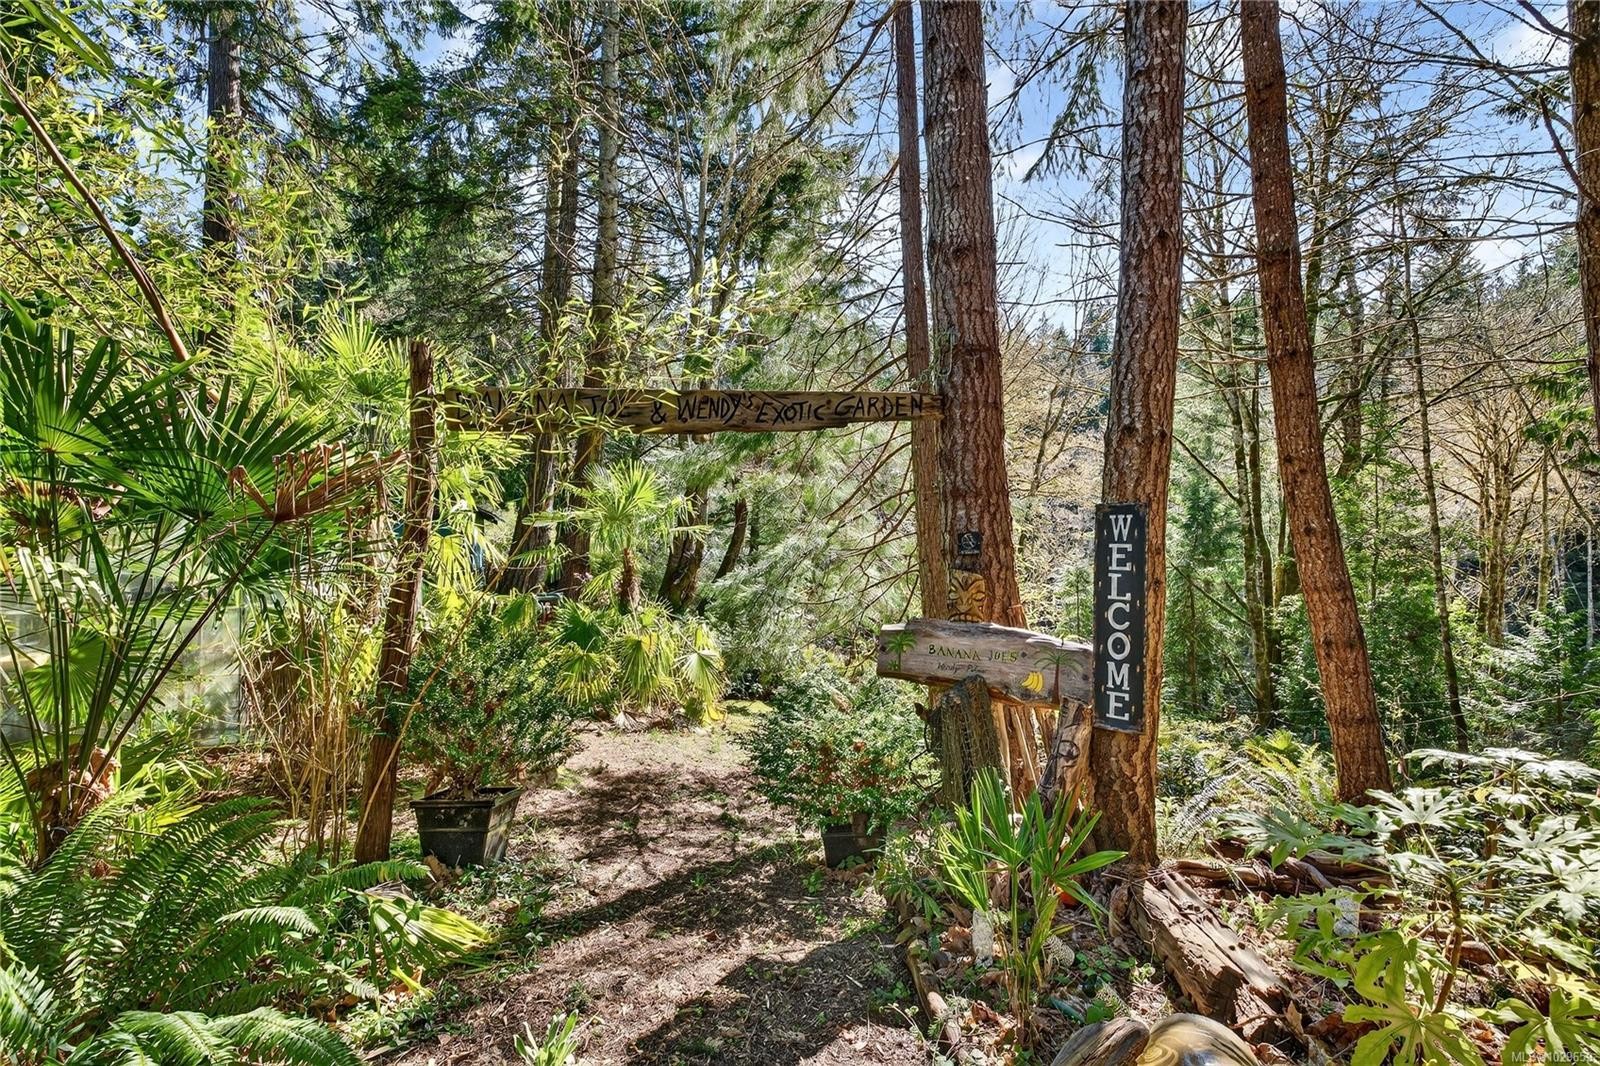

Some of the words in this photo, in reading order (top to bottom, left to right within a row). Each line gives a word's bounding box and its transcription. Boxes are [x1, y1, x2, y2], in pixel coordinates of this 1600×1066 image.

[650, 401, 666, 424] &
[756, 401, 826, 426] EXOTIC
[835, 395, 923, 419] GARDEN
[1106, 514, 1133, 721] WELCOME
[928, 644, 980, 661] BANANA
